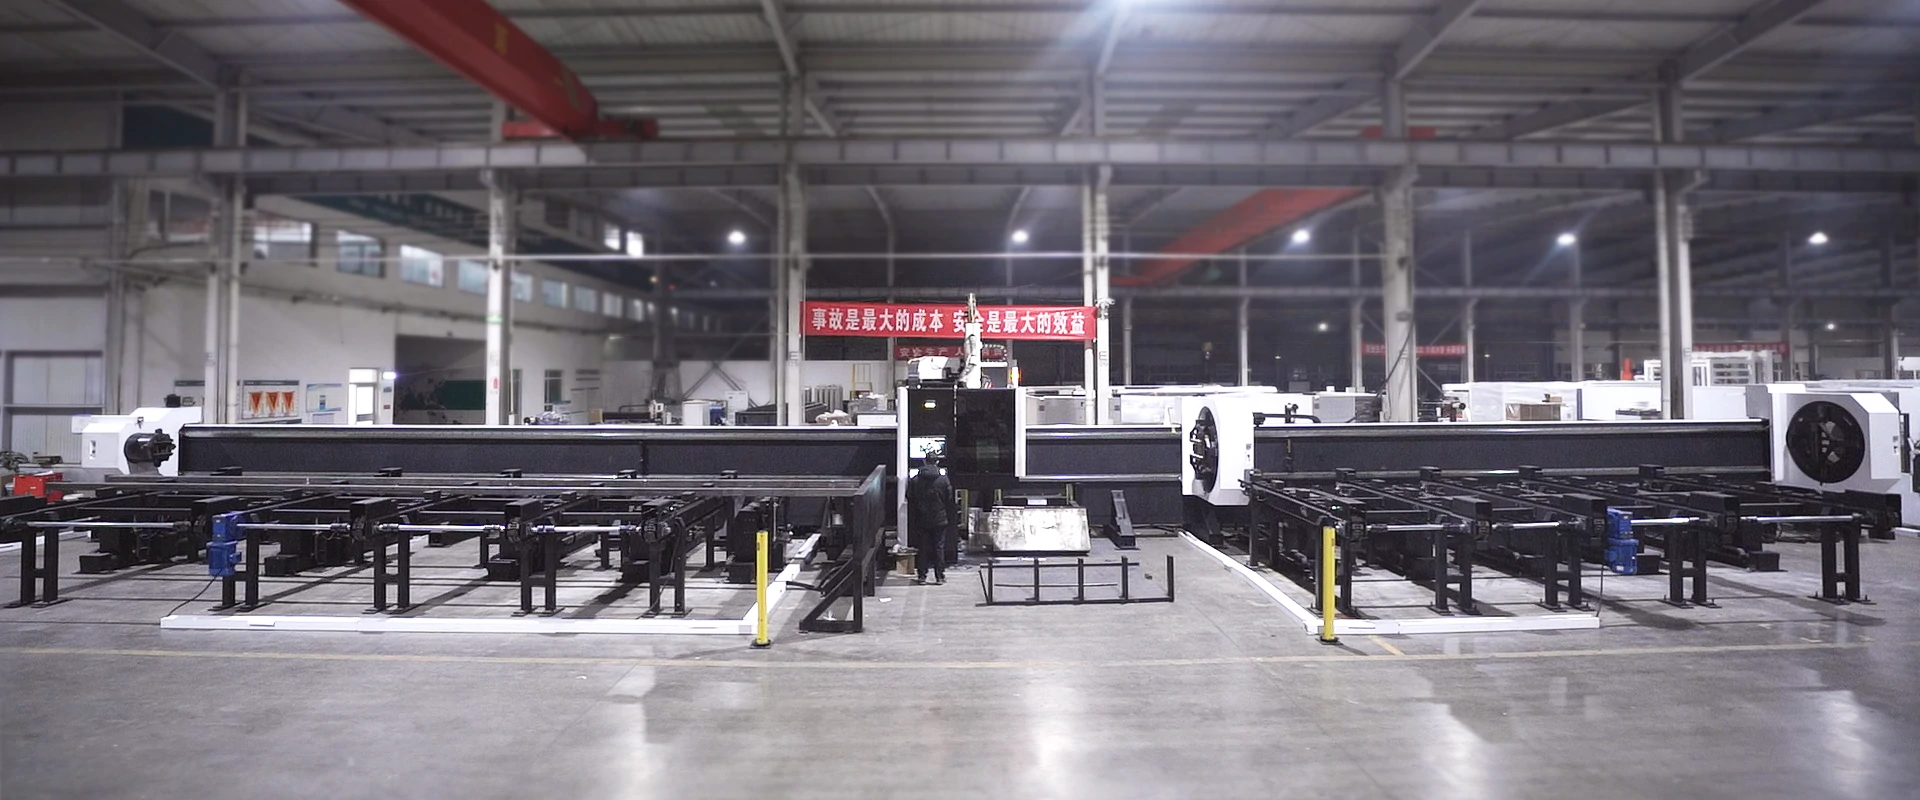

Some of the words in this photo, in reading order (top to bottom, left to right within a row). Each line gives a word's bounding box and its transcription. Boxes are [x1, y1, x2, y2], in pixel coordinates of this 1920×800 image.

[812, 308, 943, 332] 事故是最大的成本
